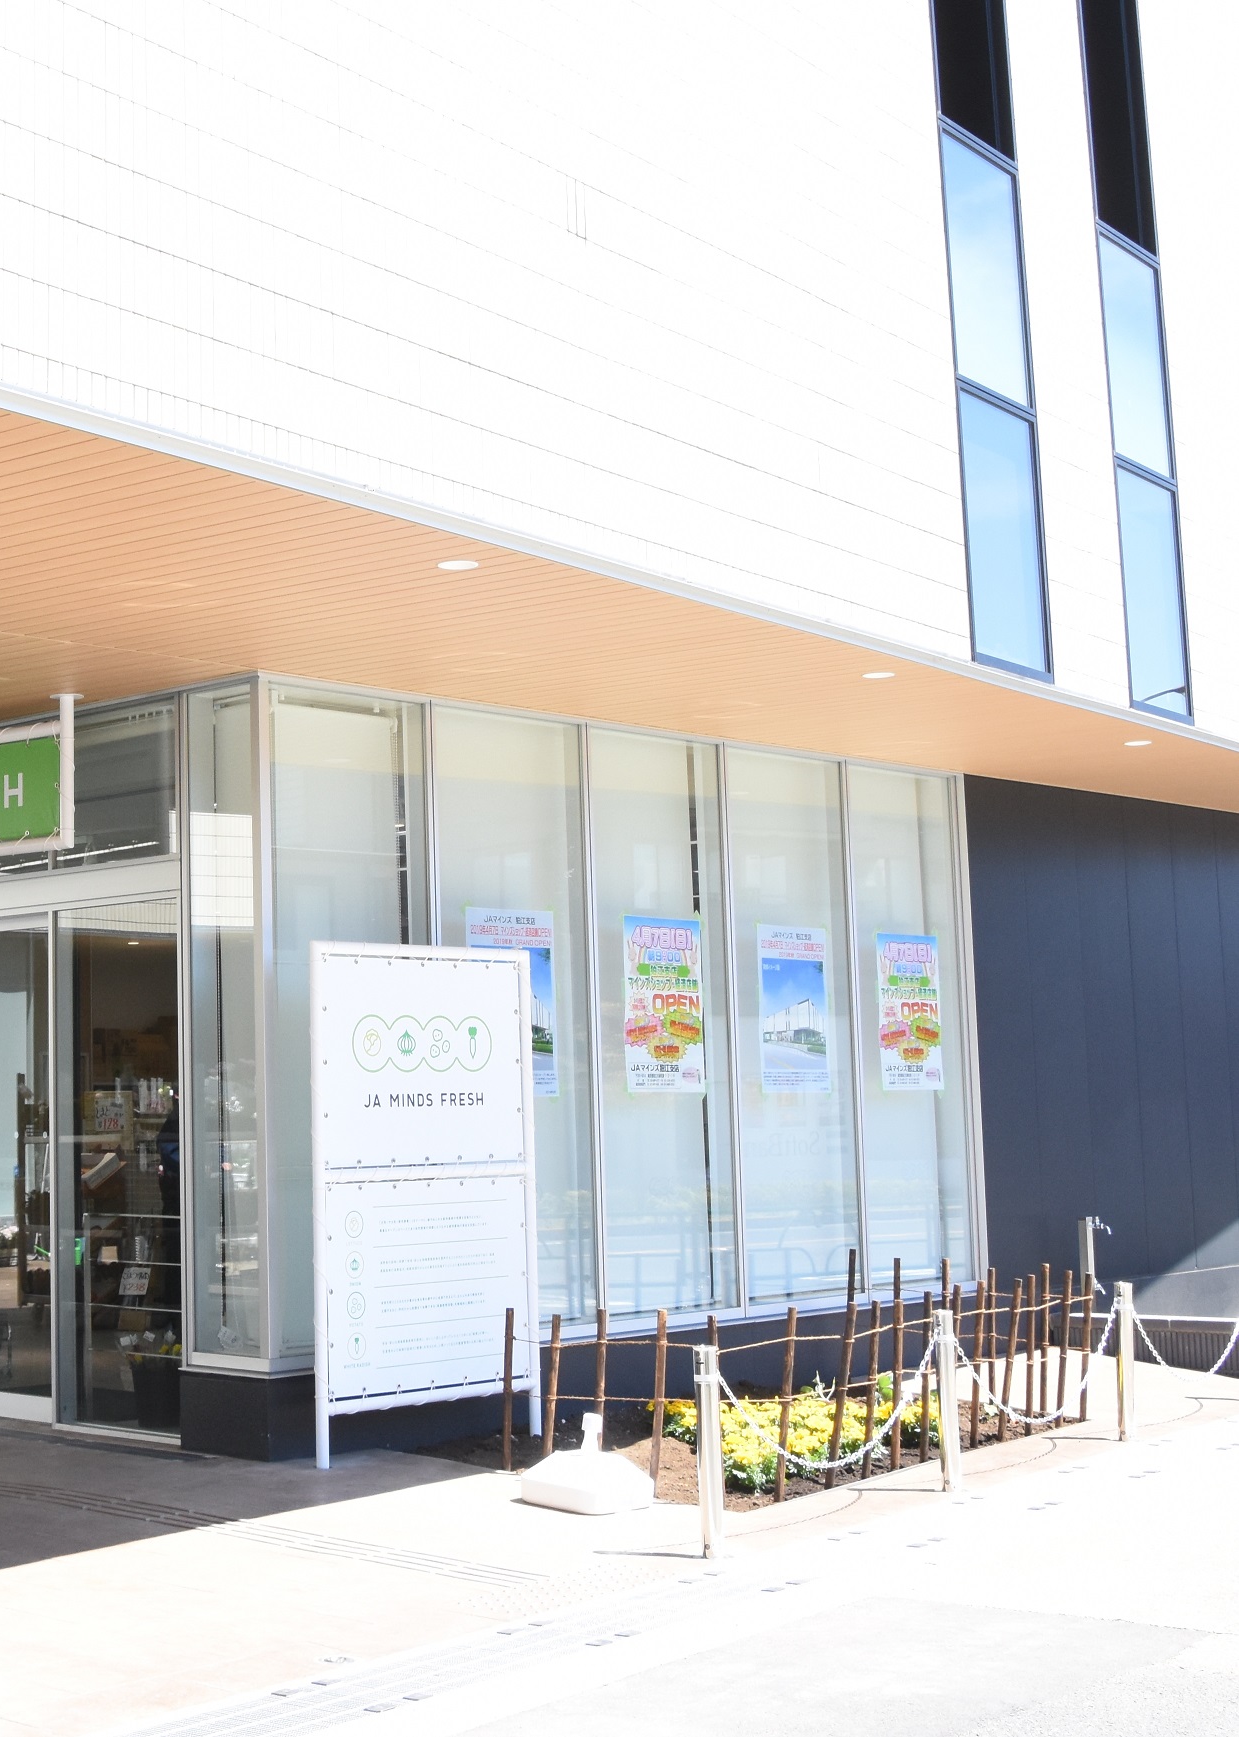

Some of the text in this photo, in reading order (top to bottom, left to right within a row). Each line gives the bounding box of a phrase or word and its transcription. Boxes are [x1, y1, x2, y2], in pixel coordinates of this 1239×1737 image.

[483, 915, 512, 923] JAマインズ
[652, 993, 701, 1014] OPEN
[901, 1001, 939, 1020] OPEN
[364, 1092, 484, 1108] JA MINDS FRESH
